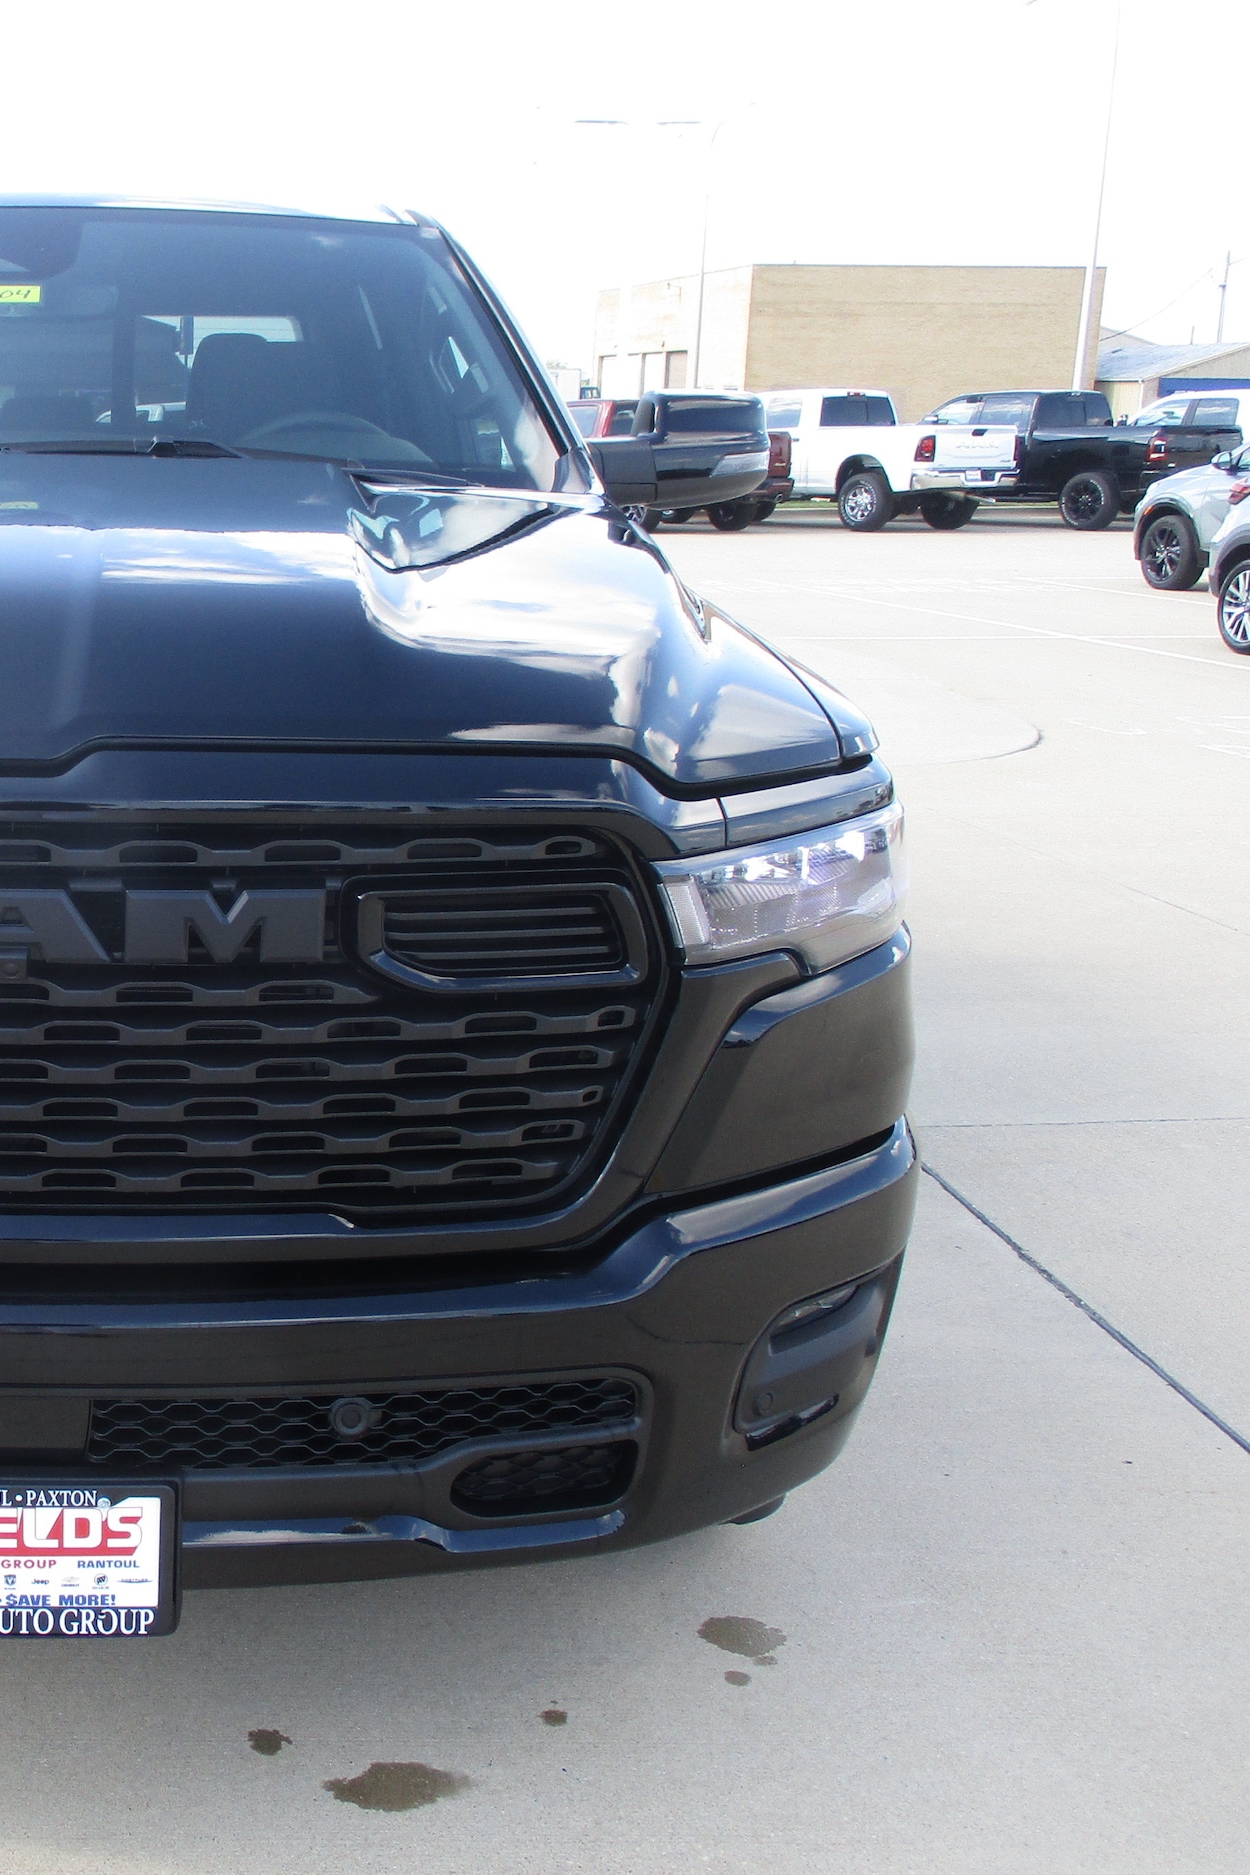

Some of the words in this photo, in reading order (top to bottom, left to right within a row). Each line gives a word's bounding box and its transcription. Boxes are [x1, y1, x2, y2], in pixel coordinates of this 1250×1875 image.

[26, 1490, 98, 1507] PAXTON
[1, 1559, 57, 1569] GROUP
[77, 1560, 140, 1569] RANTOUL
[59, 1594, 116, 1606] MORE!
[59, 1608, 155, 1635] GROUP
